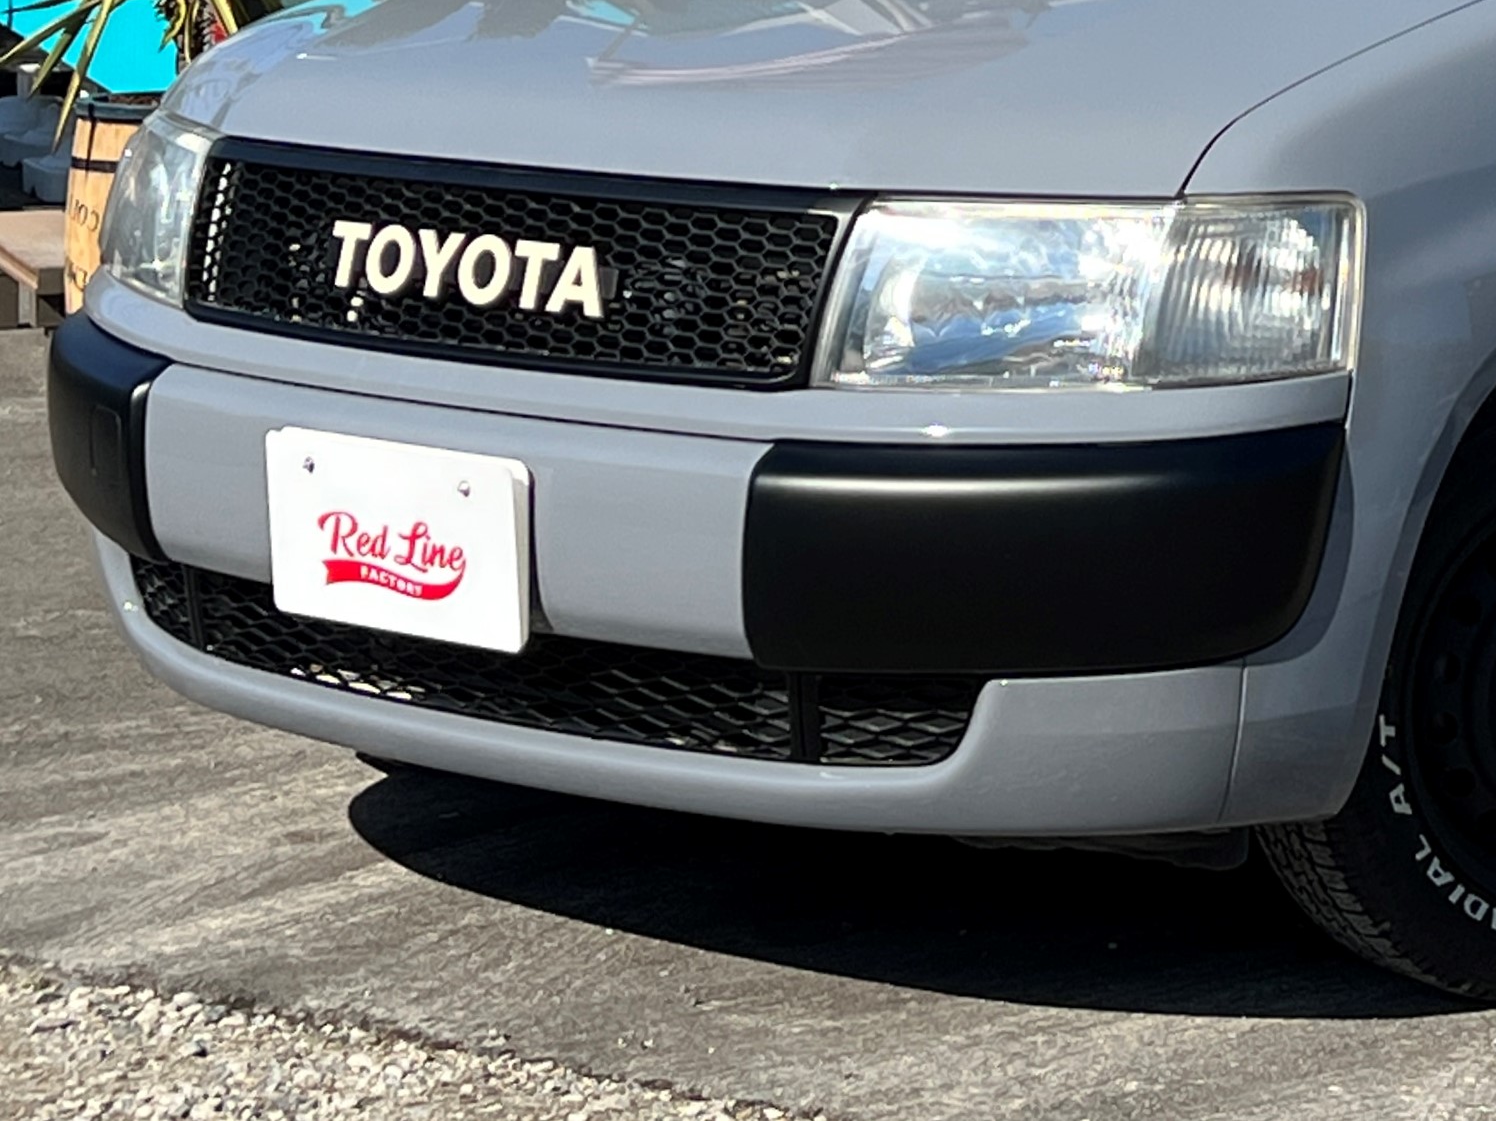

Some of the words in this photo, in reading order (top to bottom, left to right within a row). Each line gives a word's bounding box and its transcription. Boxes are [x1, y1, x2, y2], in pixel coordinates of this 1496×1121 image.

[332, 220, 603, 318] TOYOTA
[317, 510, 392, 560] Red
[393, 521, 466, 574] Line
[359, 564, 424, 598] FACTORY
[1379, 714, 1413, 816] A/T
